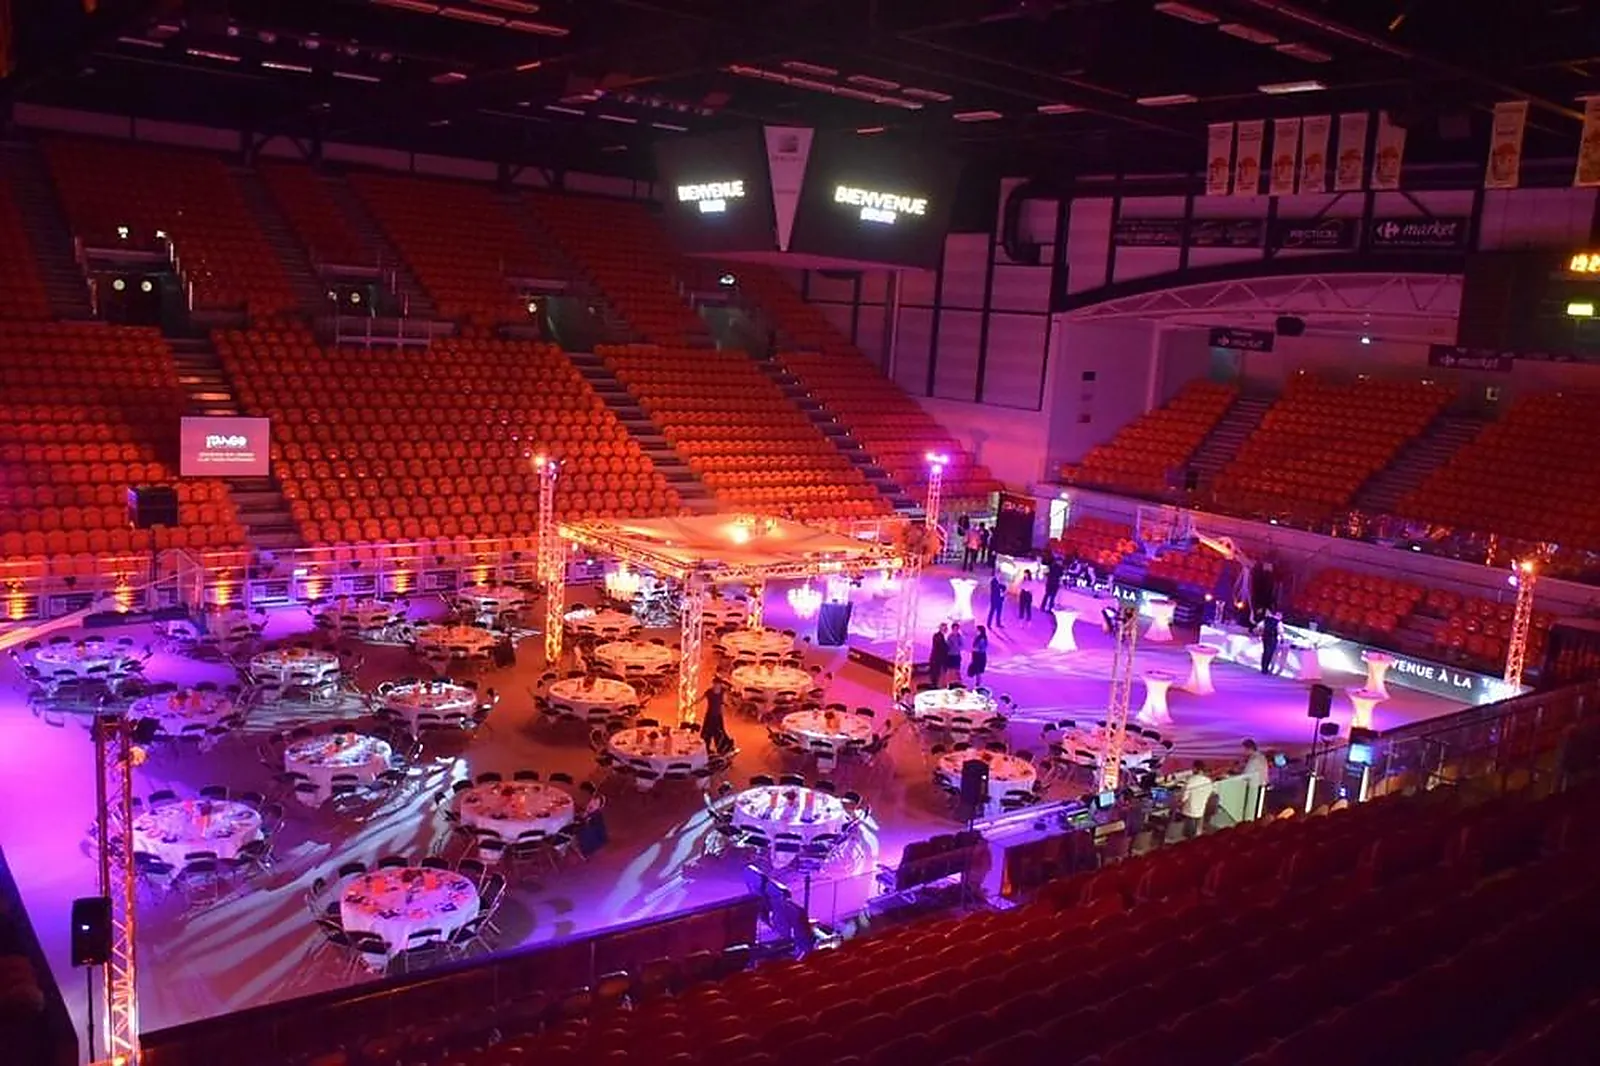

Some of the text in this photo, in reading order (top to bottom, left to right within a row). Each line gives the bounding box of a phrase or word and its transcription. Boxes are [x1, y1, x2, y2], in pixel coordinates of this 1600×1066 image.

[678, 180, 745, 201] BIENVENUE
[834, 186, 928, 215] BIENVENUE
[1403, 220, 1458, 239] market
[1453, 674, 1473, 690] LA
